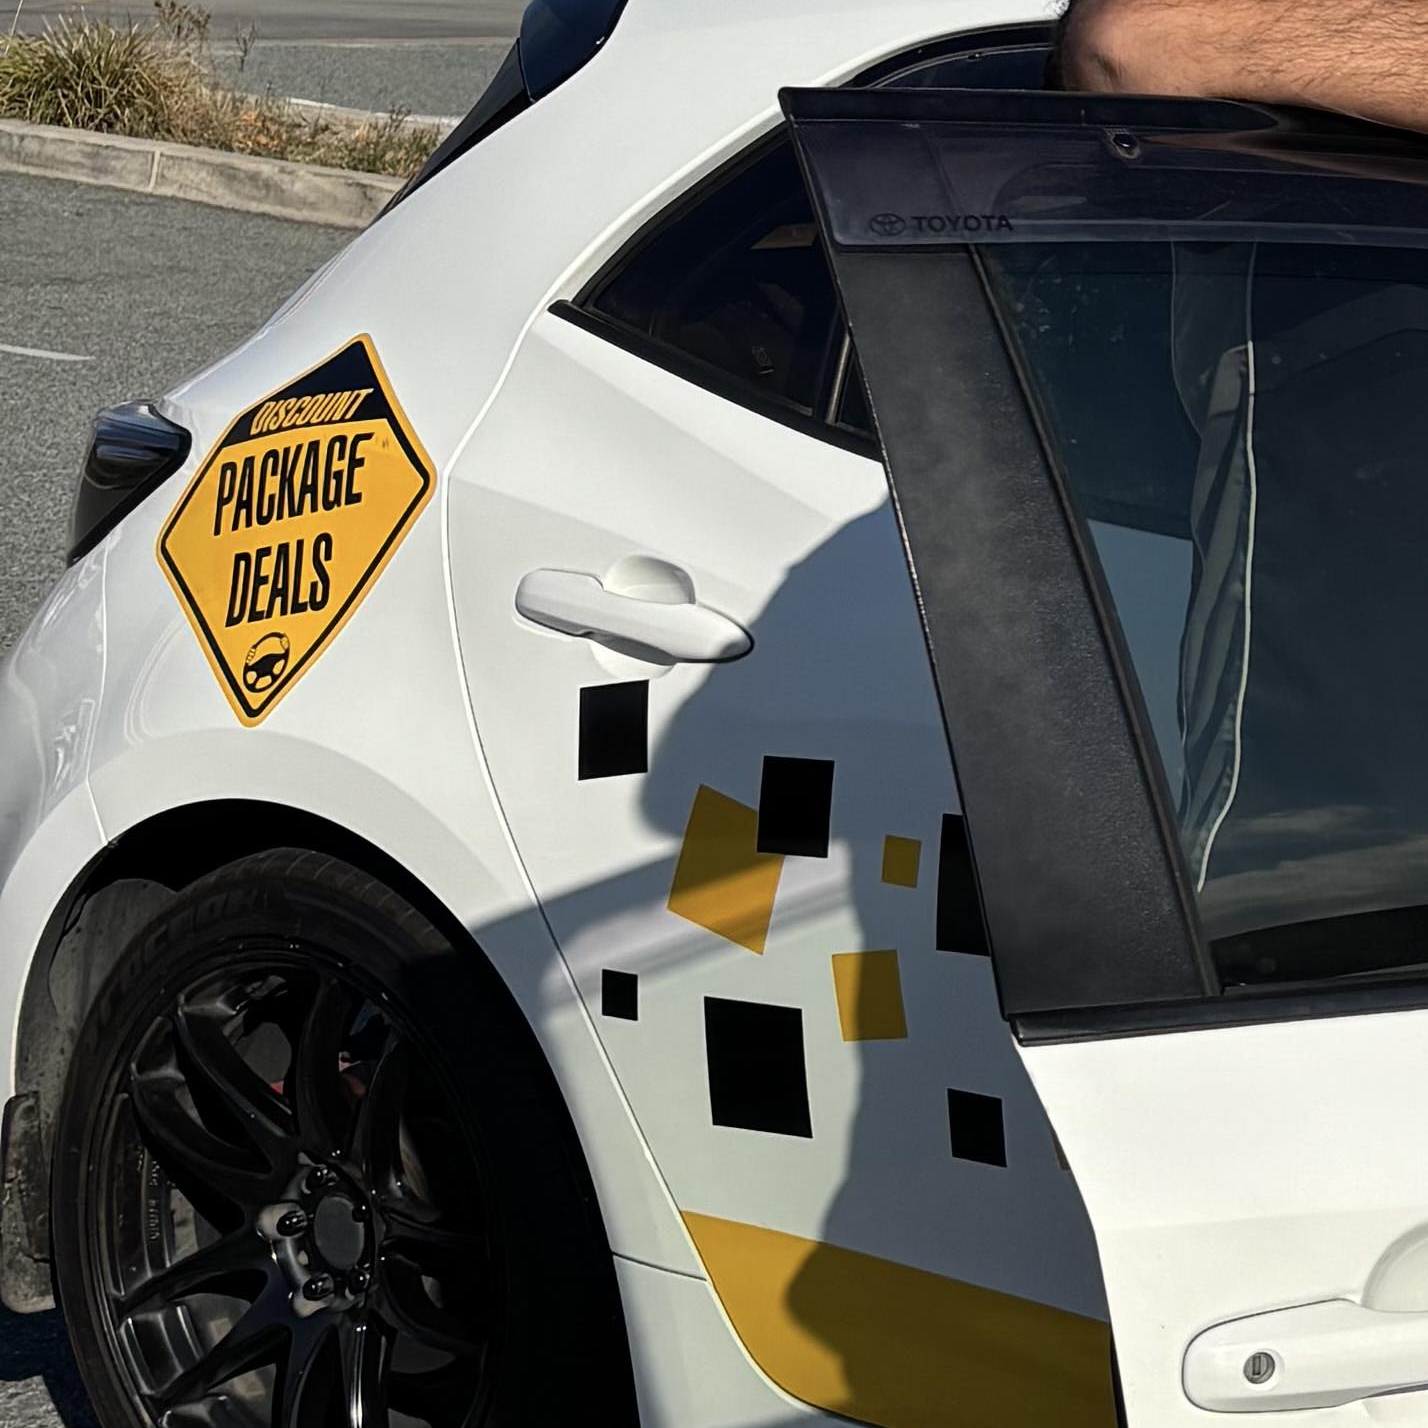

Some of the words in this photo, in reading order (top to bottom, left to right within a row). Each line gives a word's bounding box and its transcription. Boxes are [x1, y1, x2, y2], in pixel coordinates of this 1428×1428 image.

[911, 215, 1014, 232] TOYOTA
[250, 388, 375, 436] DISCOUNT
[213, 432, 374, 537] PACKAGE
[225, 532, 333, 628] DEALS
